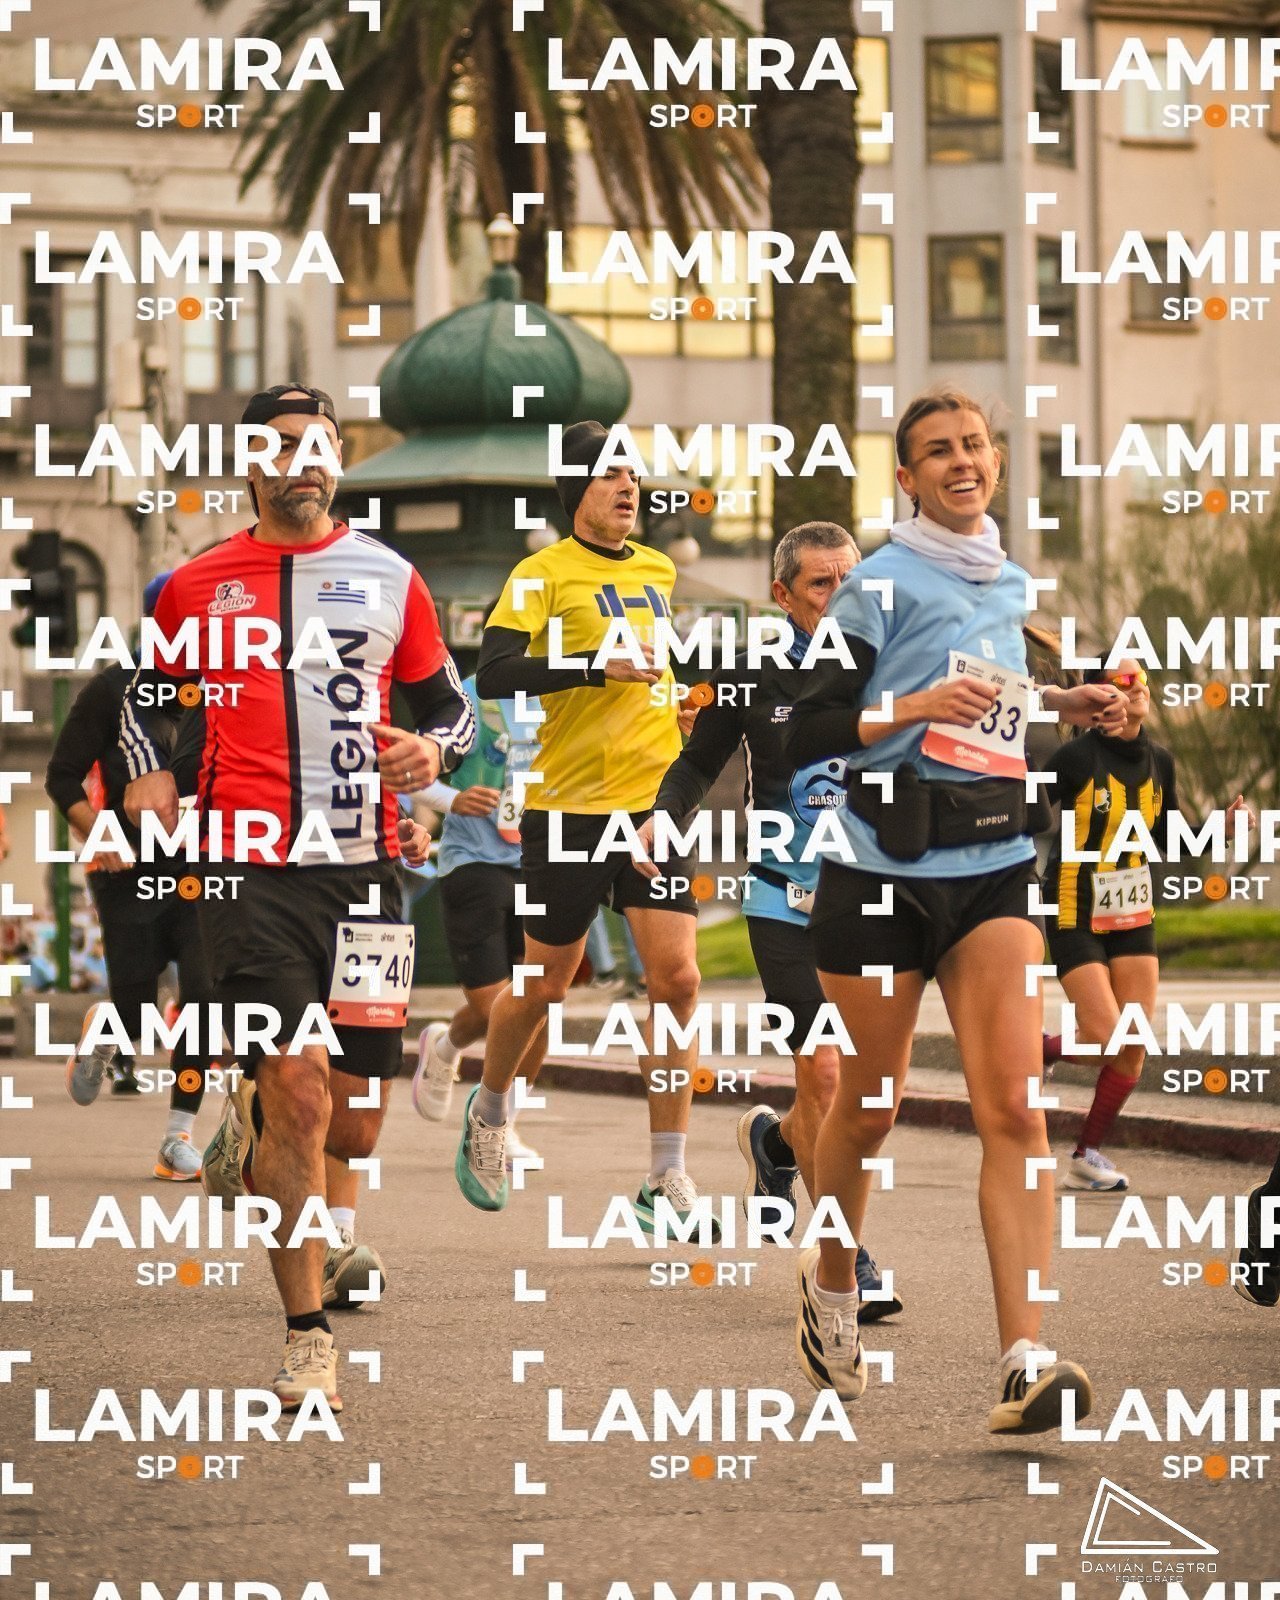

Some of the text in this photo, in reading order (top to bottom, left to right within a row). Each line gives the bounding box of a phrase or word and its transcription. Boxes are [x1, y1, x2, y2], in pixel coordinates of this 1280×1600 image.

[313, 629, 368, 839] LEGIÓN
[975, 814, 1009, 827] KIPRUN
[1099, 883, 1149, 909] 4143
[341, 953, 411, 989] 3740
